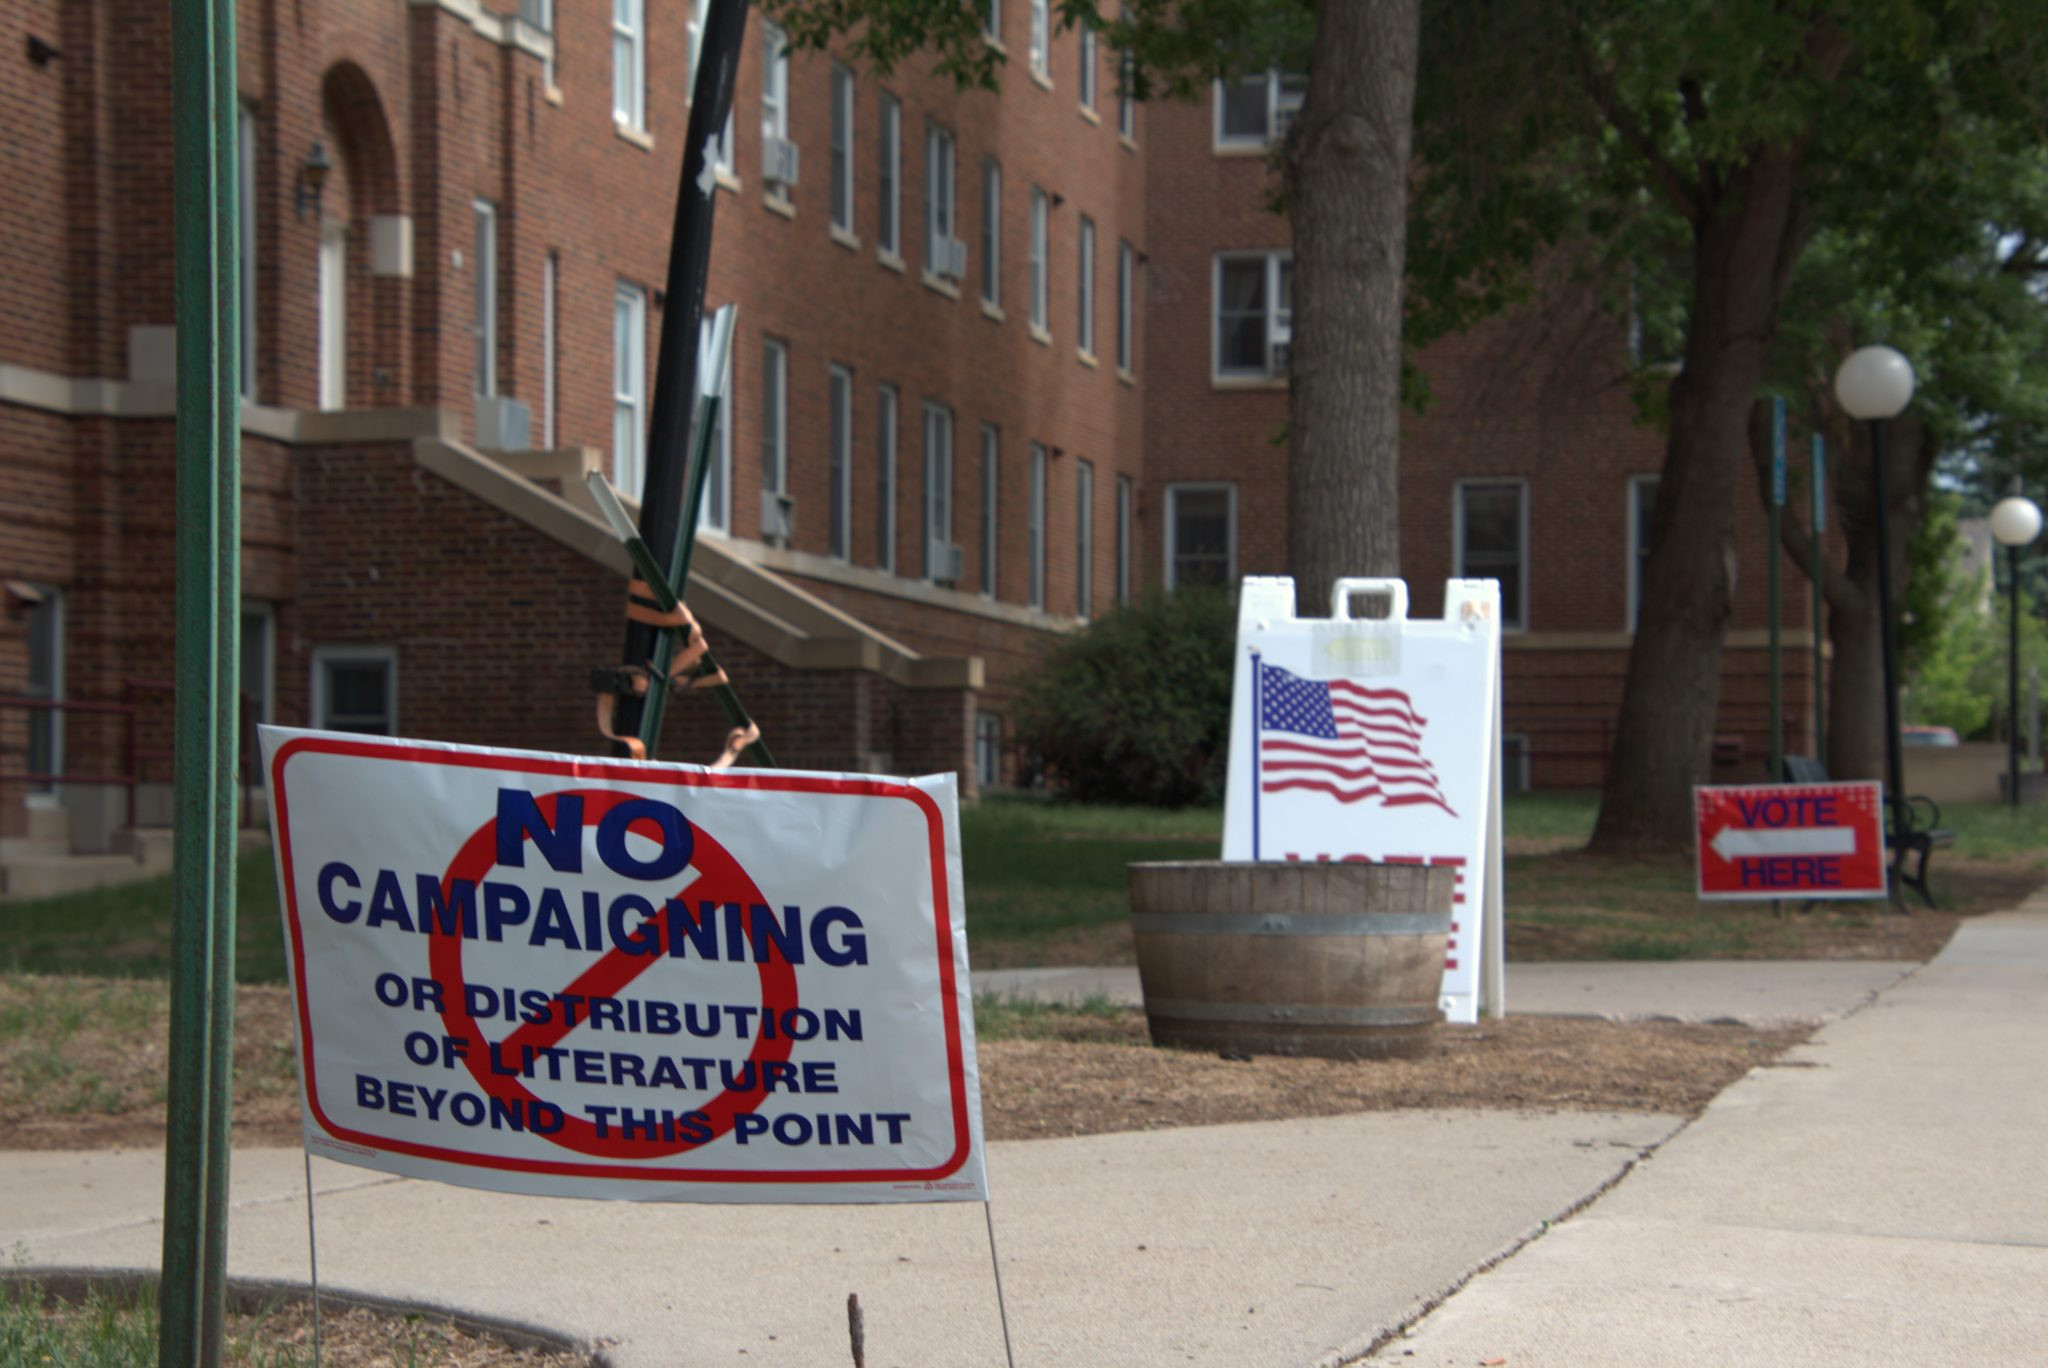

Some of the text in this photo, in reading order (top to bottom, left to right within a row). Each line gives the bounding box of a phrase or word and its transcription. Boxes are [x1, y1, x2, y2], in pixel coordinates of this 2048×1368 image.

[496, 787, 694, 880] NO
[1739, 797, 1838, 828] VOTE
[1741, 857, 1841, 886] HERE
[317, 862, 869, 967] CAMPAIGNING
[375, 972, 863, 1041] OR DISTRIBUTION
[404, 1031, 838, 1094] OF LITERATURE
[355, 1074, 912, 1146] BEYOND THIS POINT
